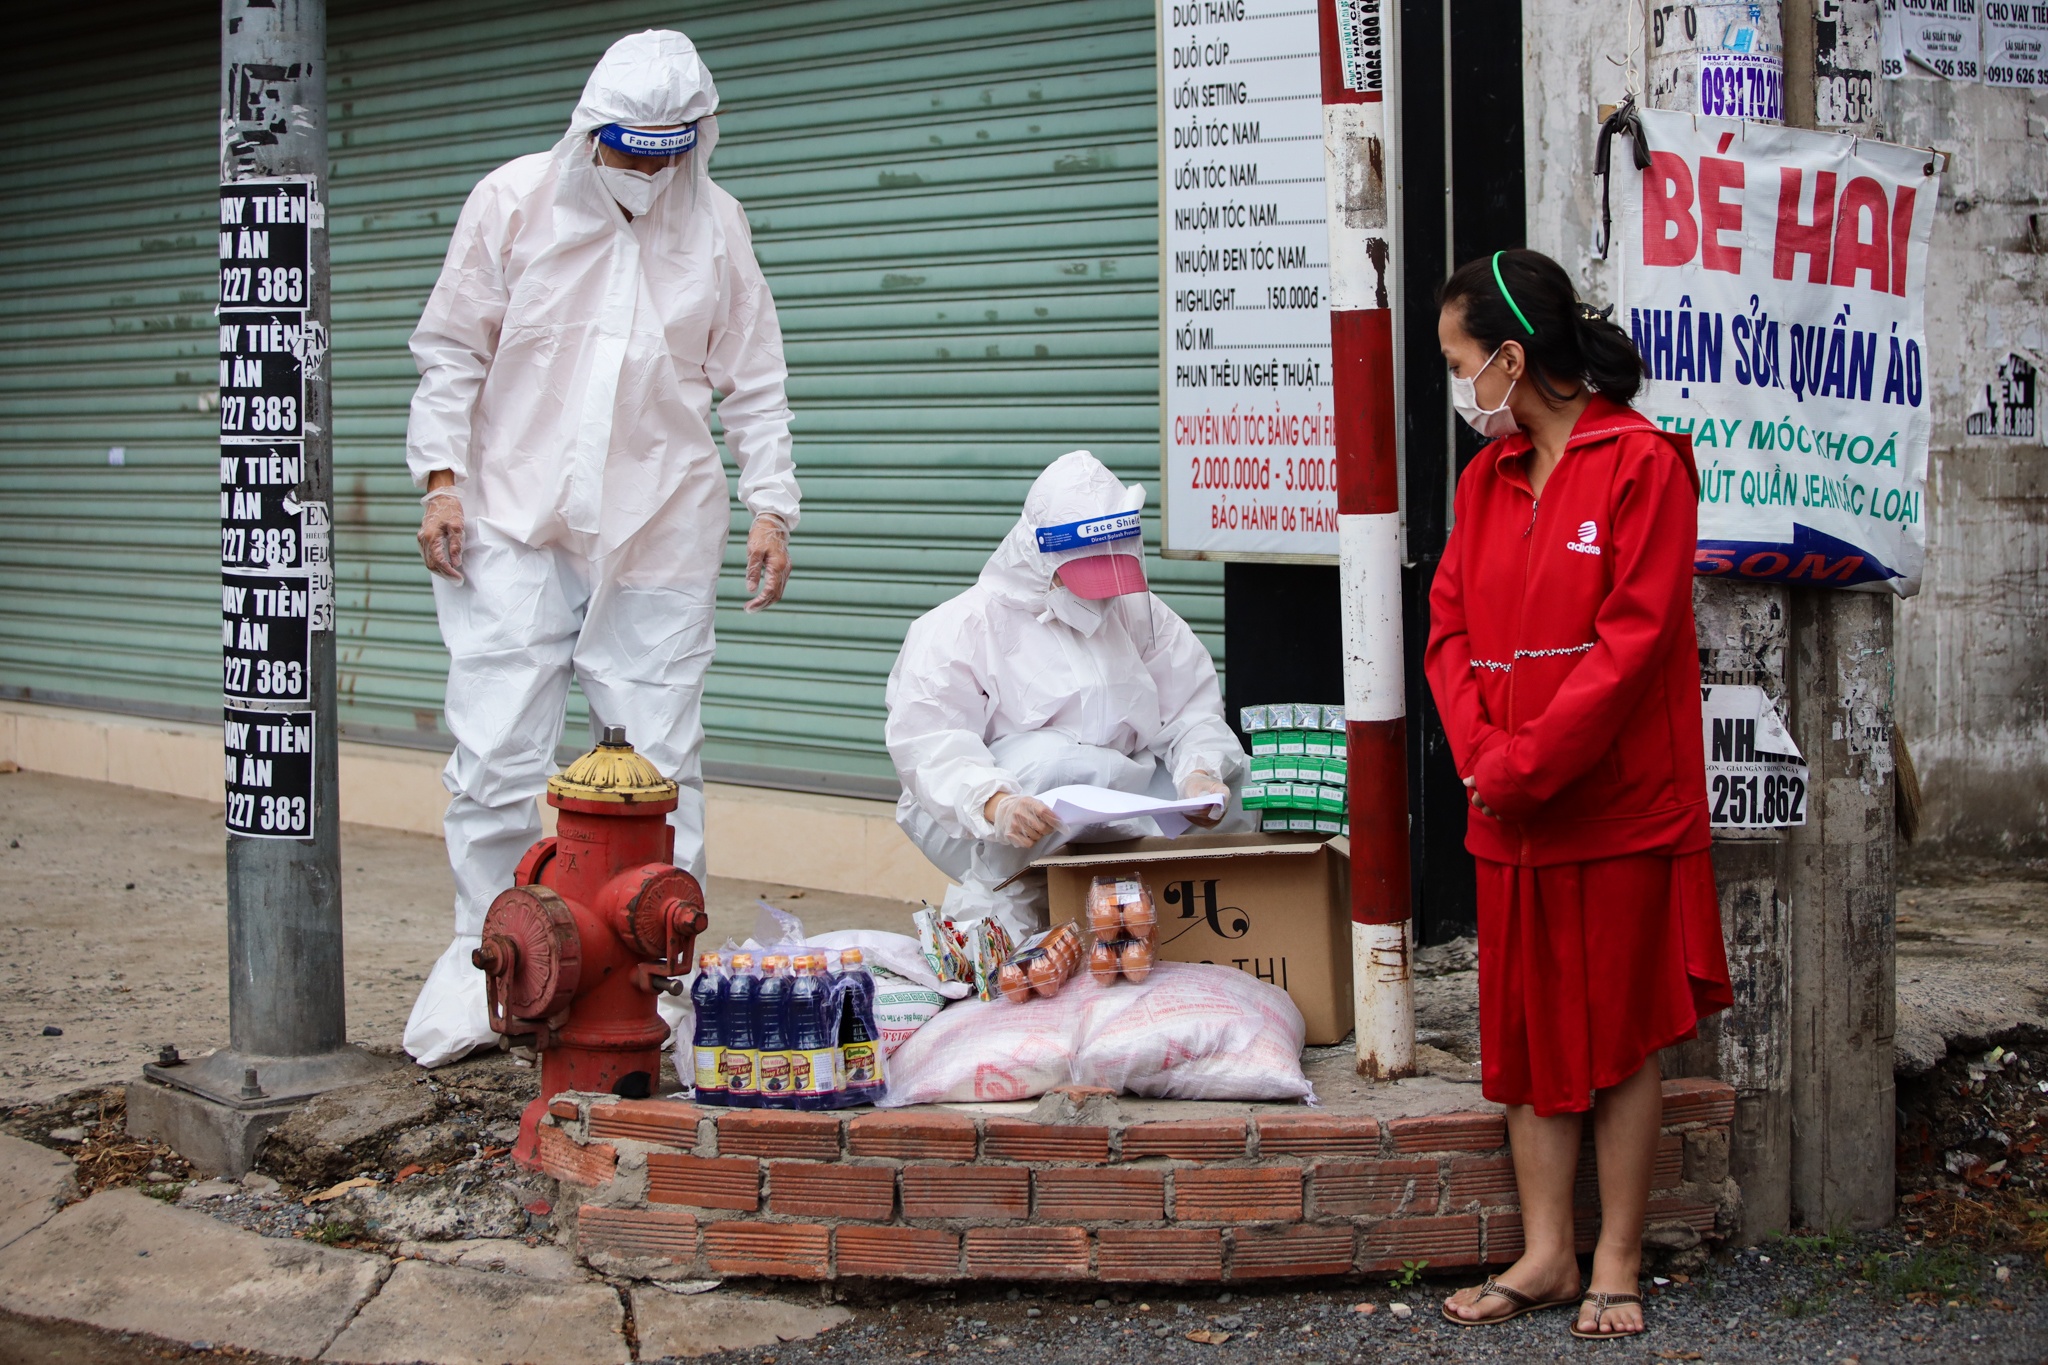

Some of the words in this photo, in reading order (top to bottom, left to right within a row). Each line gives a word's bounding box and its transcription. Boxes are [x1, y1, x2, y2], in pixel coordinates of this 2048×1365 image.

[1986, 2, 2009, 20] CHO
[2011, 4, 2029, 22] VAY
[1205, 37, 1230, 67] CÚP
[1958, 61, 1977, 77] 358
[1988, 66, 2013, 83] 0919
[2016, 67, 2035, 84] 626
[1202, 82, 1247, 107] SETTING
[630, 136, 656, 146] Face
[660, 133, 691, 146] Shield
[1206, 118, 1229, 146] TÓC
[1233, 122, 1260, 144] NAM
[1204, 160, 1226, 188] TÓC
[1230, 163, 1258, 186] NAM
[252, 188, 306, 223] TIỀN
[1175, 203, 1219, 234] NHUỘM
[1223, 199, 1246, 228] TÓC
[1250, 204, 1277, 227] NAM
[1643, 132, 1745, 275] BÉ
[1773, 166, 1916, 298] HAI
[238, 226, 269, 259] ĂN
[1176, 245, 1219, 277] NHUỘM
[1223, 248, 1247, 271] ĐEN
[1251, 241, 1274, 270] TÓC
[1278, 246, 1306, 269] NAM
[224, 267, 251, 302] 227
[257, 267, 303, 302] 383
[1176, 288, 1235, 312] HIGHLIGHT
[1267, 286, 1319, 309] 150.000đ
[246, 315, 299, 352] TIỀN
[1176, 320, 1196, 350] NỐI
[1200, 328, 1214, 350] MI
[1630, 294, 1723, 399] NHẬN
[1731, 294, 1785, 390] SỬA
[1790, 304, 1877, 403] QUẦN
[1883, 321, 1922, 408] ÁO
[233, 355, 262, 387] ĂN
[1176, 365, 1207, 387] PHUN
[1211, 359, 1240, 386] THÊU
[1244, 358, 1278, 391] NGHỆ
[1283, 358, 1320, 391] THUẬT
[222, 396, 246, 430] 227
[251, 396, 297, 431] 383
[1175, 408, 1219, 446] CHUYÊN
[1223, 403, 1240, 445] NỐI
[1244, 406, 1265, 446] TÓC
[1302, 402, 1321, 446] CHỈ
[1748, 416, 1812, 453] MÓC
[1812, 431, 1899, 468] KHOÁ
[245, 448, 299, 484] TIỀN
[1191, 457, 1270, 489] 2.000.000đ
[233, 487, 262, 520] ĂN
[1212, 494, 1237, 529] BẢO
[1241, 498, 1278, 530] HÀNH
[1282, 505, 1296, 532] 06
[1741, 464, 1797, 507] QUẦN
[1870, 488, 1918, 531] LOẠI
[1085, 523, 1112, 534] Face
[1091, 535, 1107, 543] Direct
[222, 528, 246, 562] 227
[250, 527, 296, 564] 383
[1566, 541, 1601, 555] adidas
[253, 581, 307, 618] TIỀN
[238, 618, 268, 651] ĂN
[225, 656, 251, 692] 227
[257, 660, 302, 694] 383
[257, 717, 310, 753] TIỀN
[242, 754, 272, 787] ĂN
[228, 792, 255, 828] 227
[260, 795, 306, 831] 383
